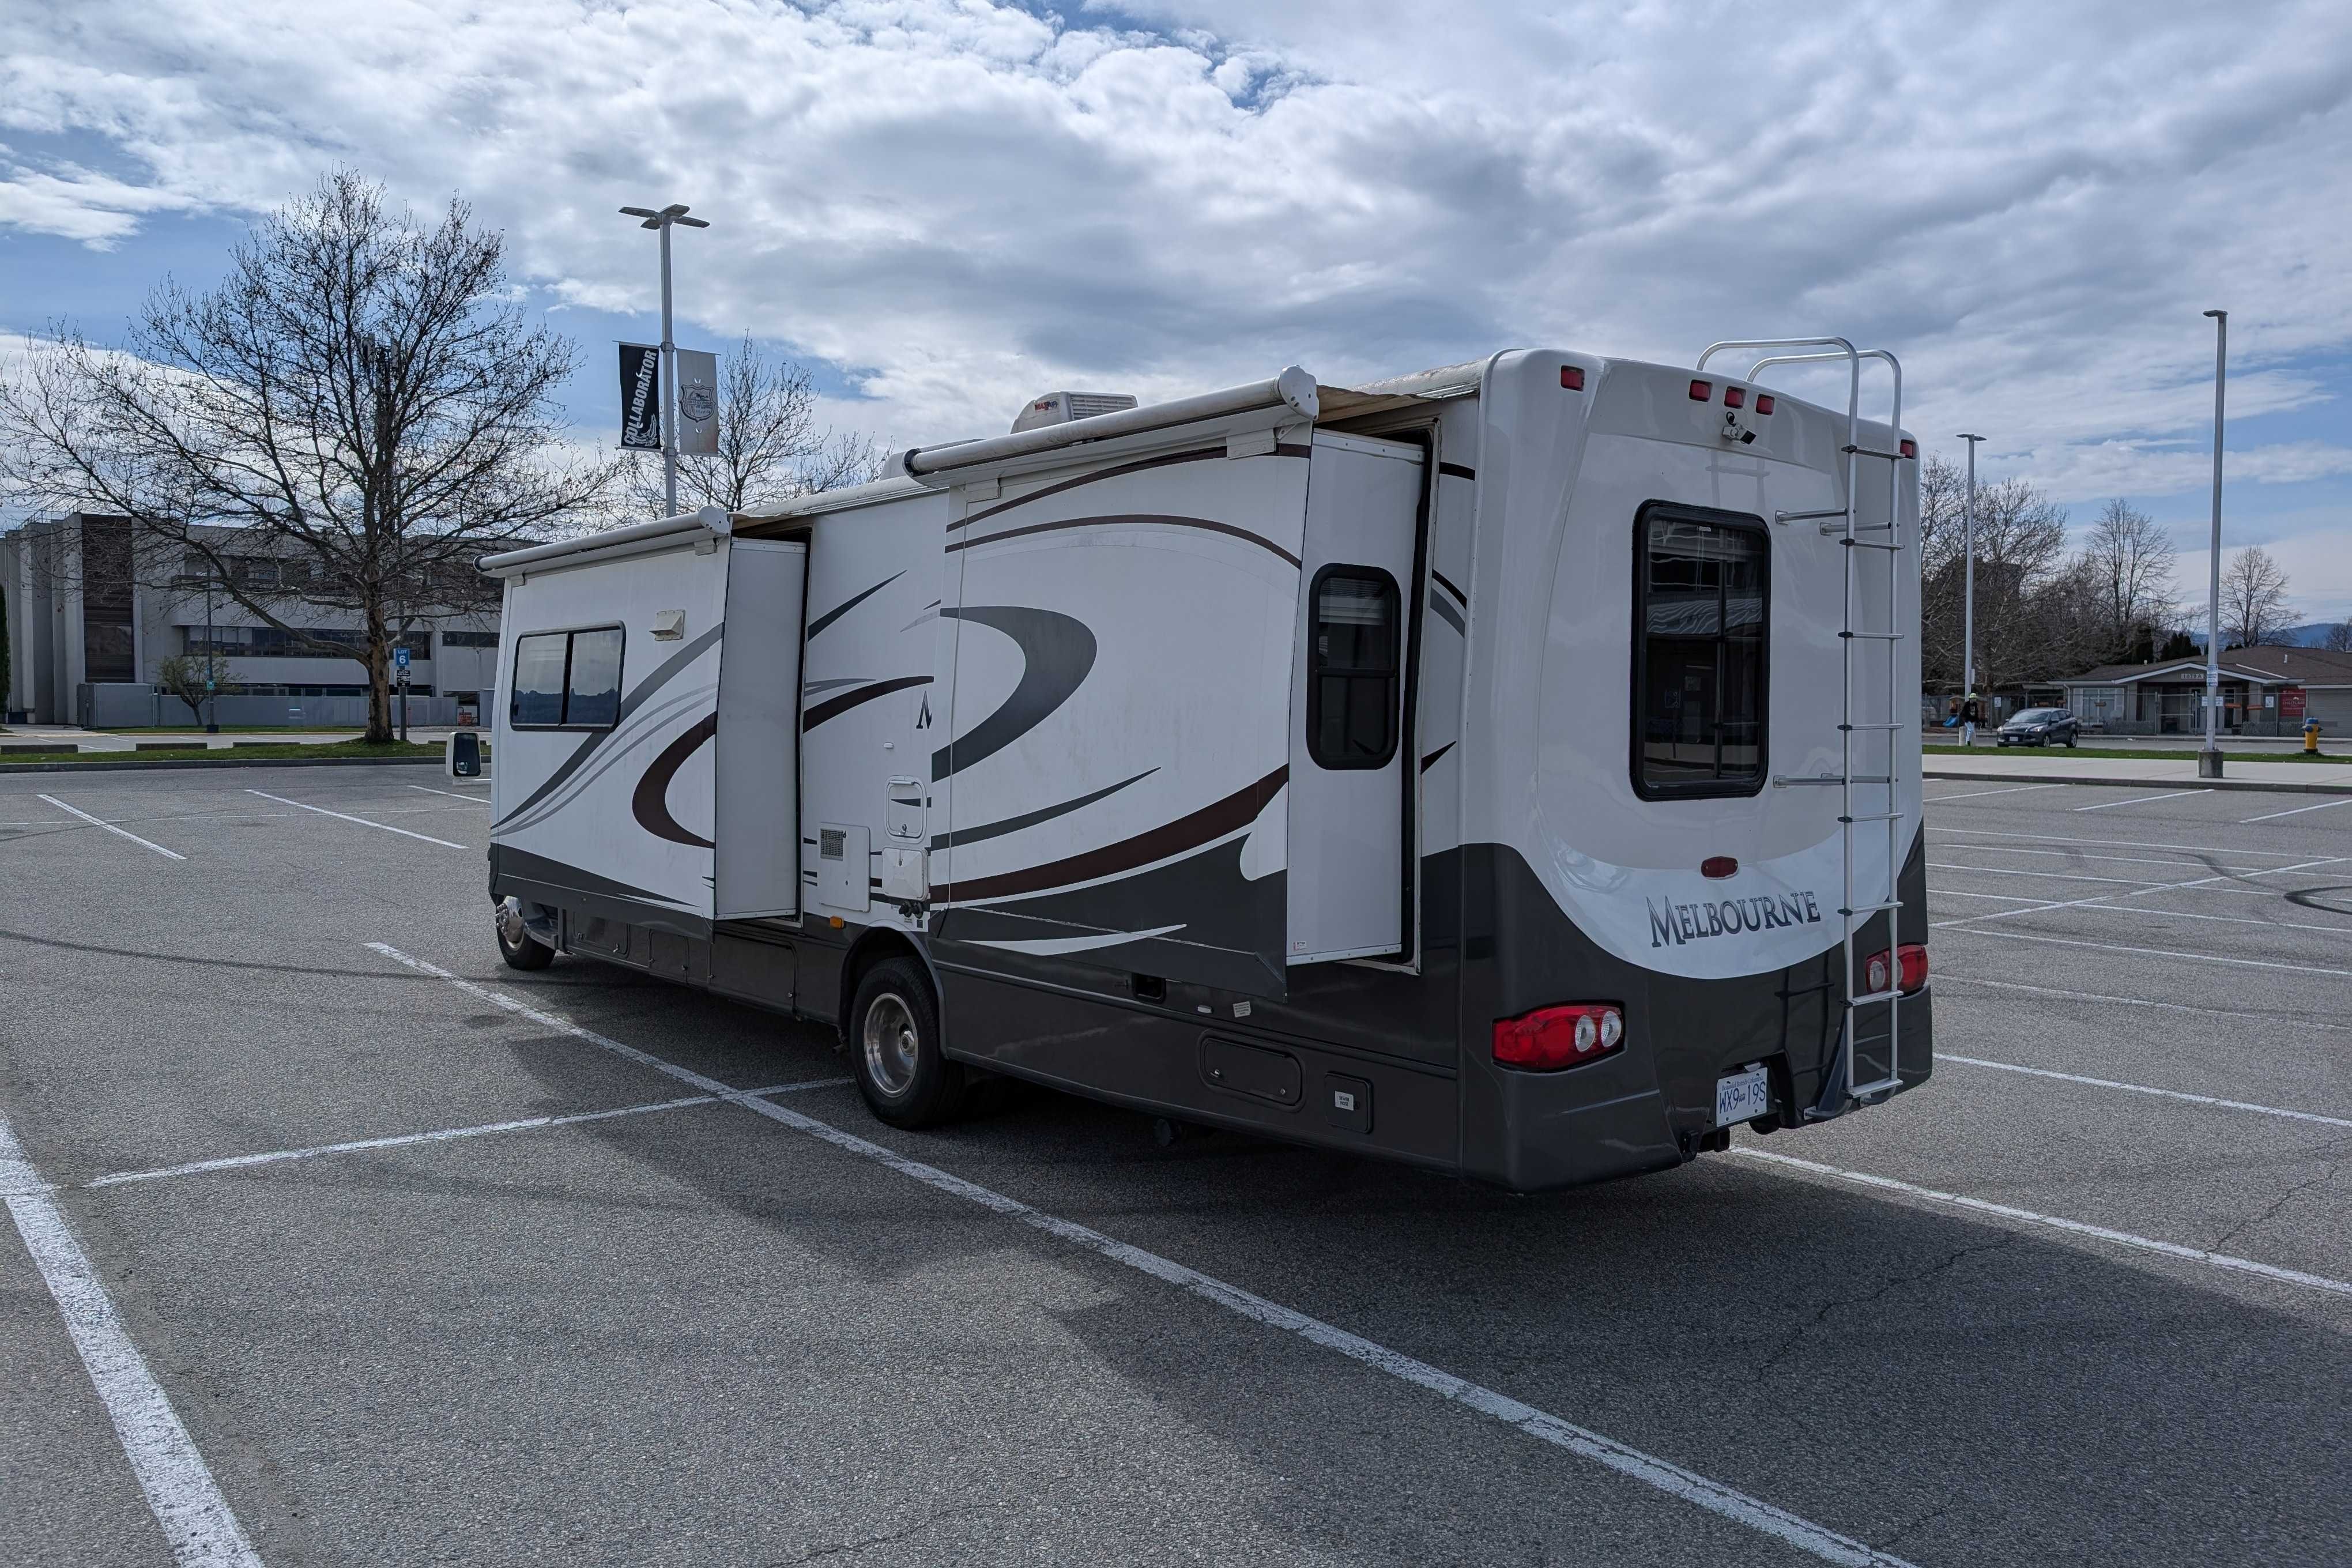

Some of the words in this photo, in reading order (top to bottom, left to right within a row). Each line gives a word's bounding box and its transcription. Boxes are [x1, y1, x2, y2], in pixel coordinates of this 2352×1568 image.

[624, 350, 657, 445] COLLABORATOR
[399, 655, 406, 664] 6
[1646, 890, 1821, 948] MELBOURNE
[1720, 1088, 1740, 1114] WX9
[1748, 1081, 1766, 1106] 19S
